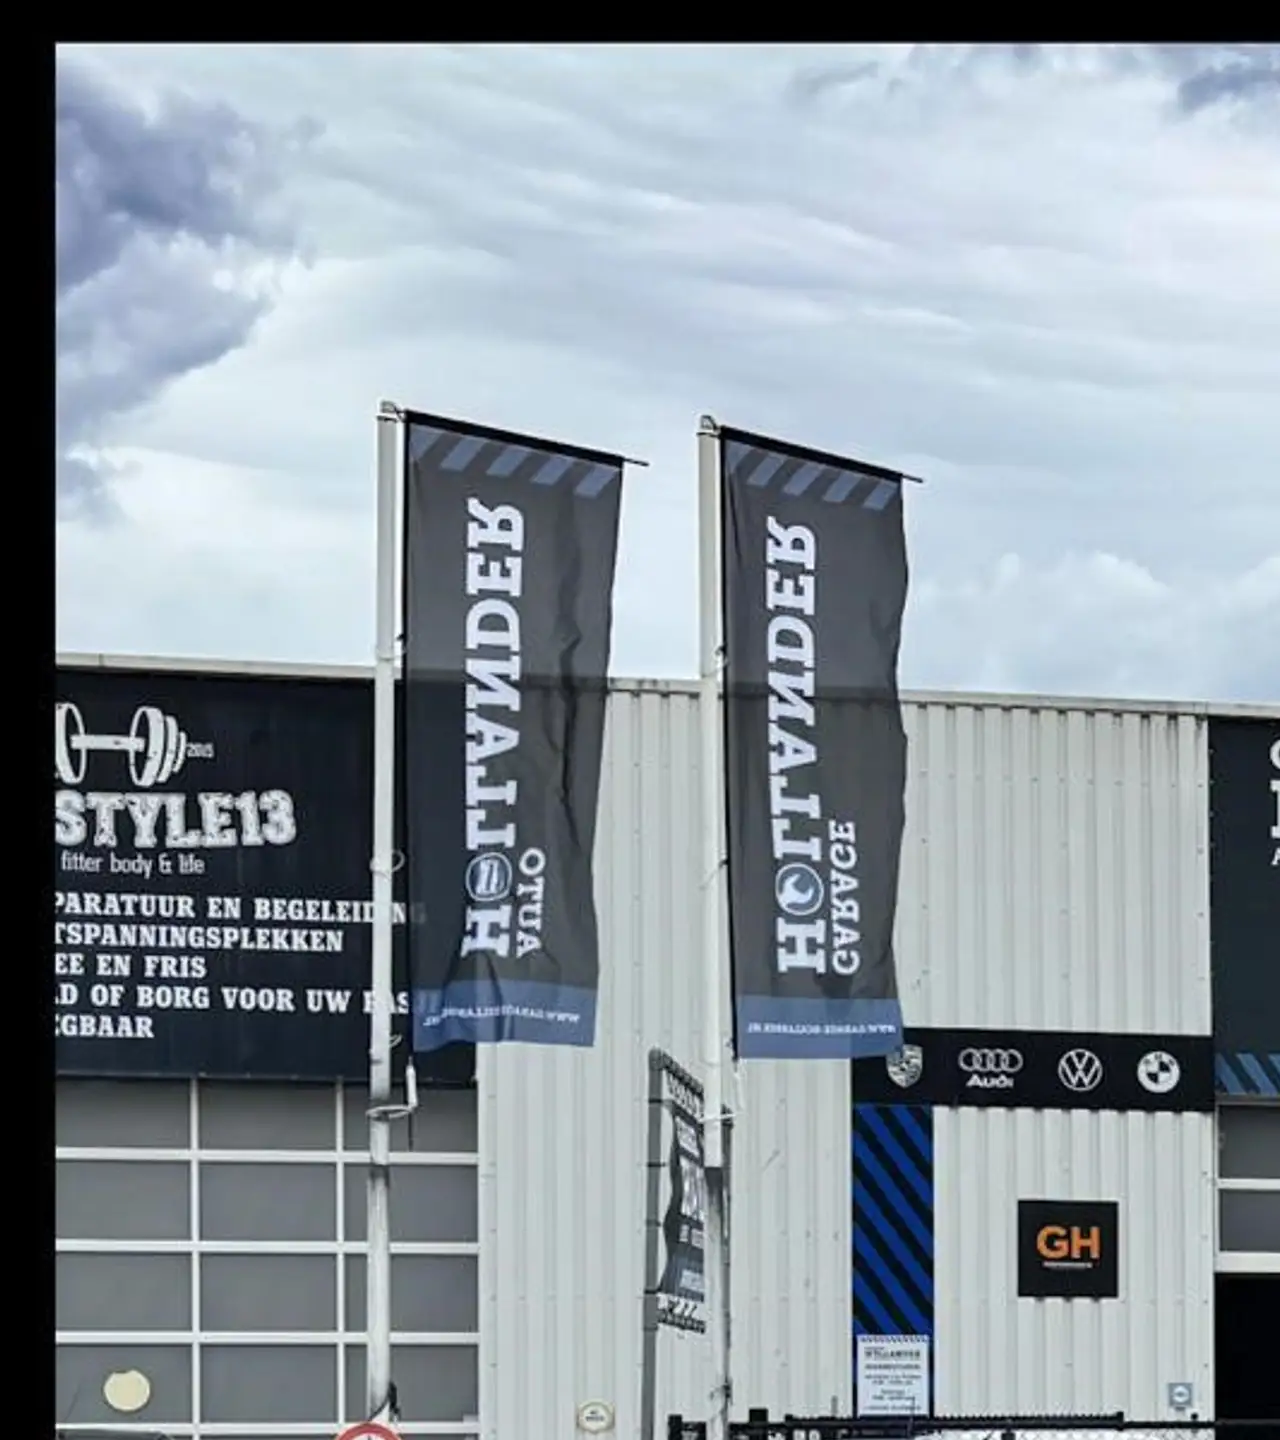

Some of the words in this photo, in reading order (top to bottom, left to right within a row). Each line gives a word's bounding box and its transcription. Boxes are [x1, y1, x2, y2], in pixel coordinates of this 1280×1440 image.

[56, 789, 297, 848] STYLE13
[60, 852, 103, 873] fitter
[109, 851, 153, 880] body
[158, 853, 173, 874] &
[177, 852, 206, 875] life
[207, 896, 241, 919] EN
[96, 953, 131, 977] EN
[144, 955, 207, 979] FRIS
[90, 983, 125, 1007] OF
[136, 985, 210, 1009] BORG
[221, 987, 295, 1012] VOOR
[306, 989, 352, 1013] UW
[55, 1013, 155, 1038] GBAAR
[1036, 1223, 1101, 1260] GH
